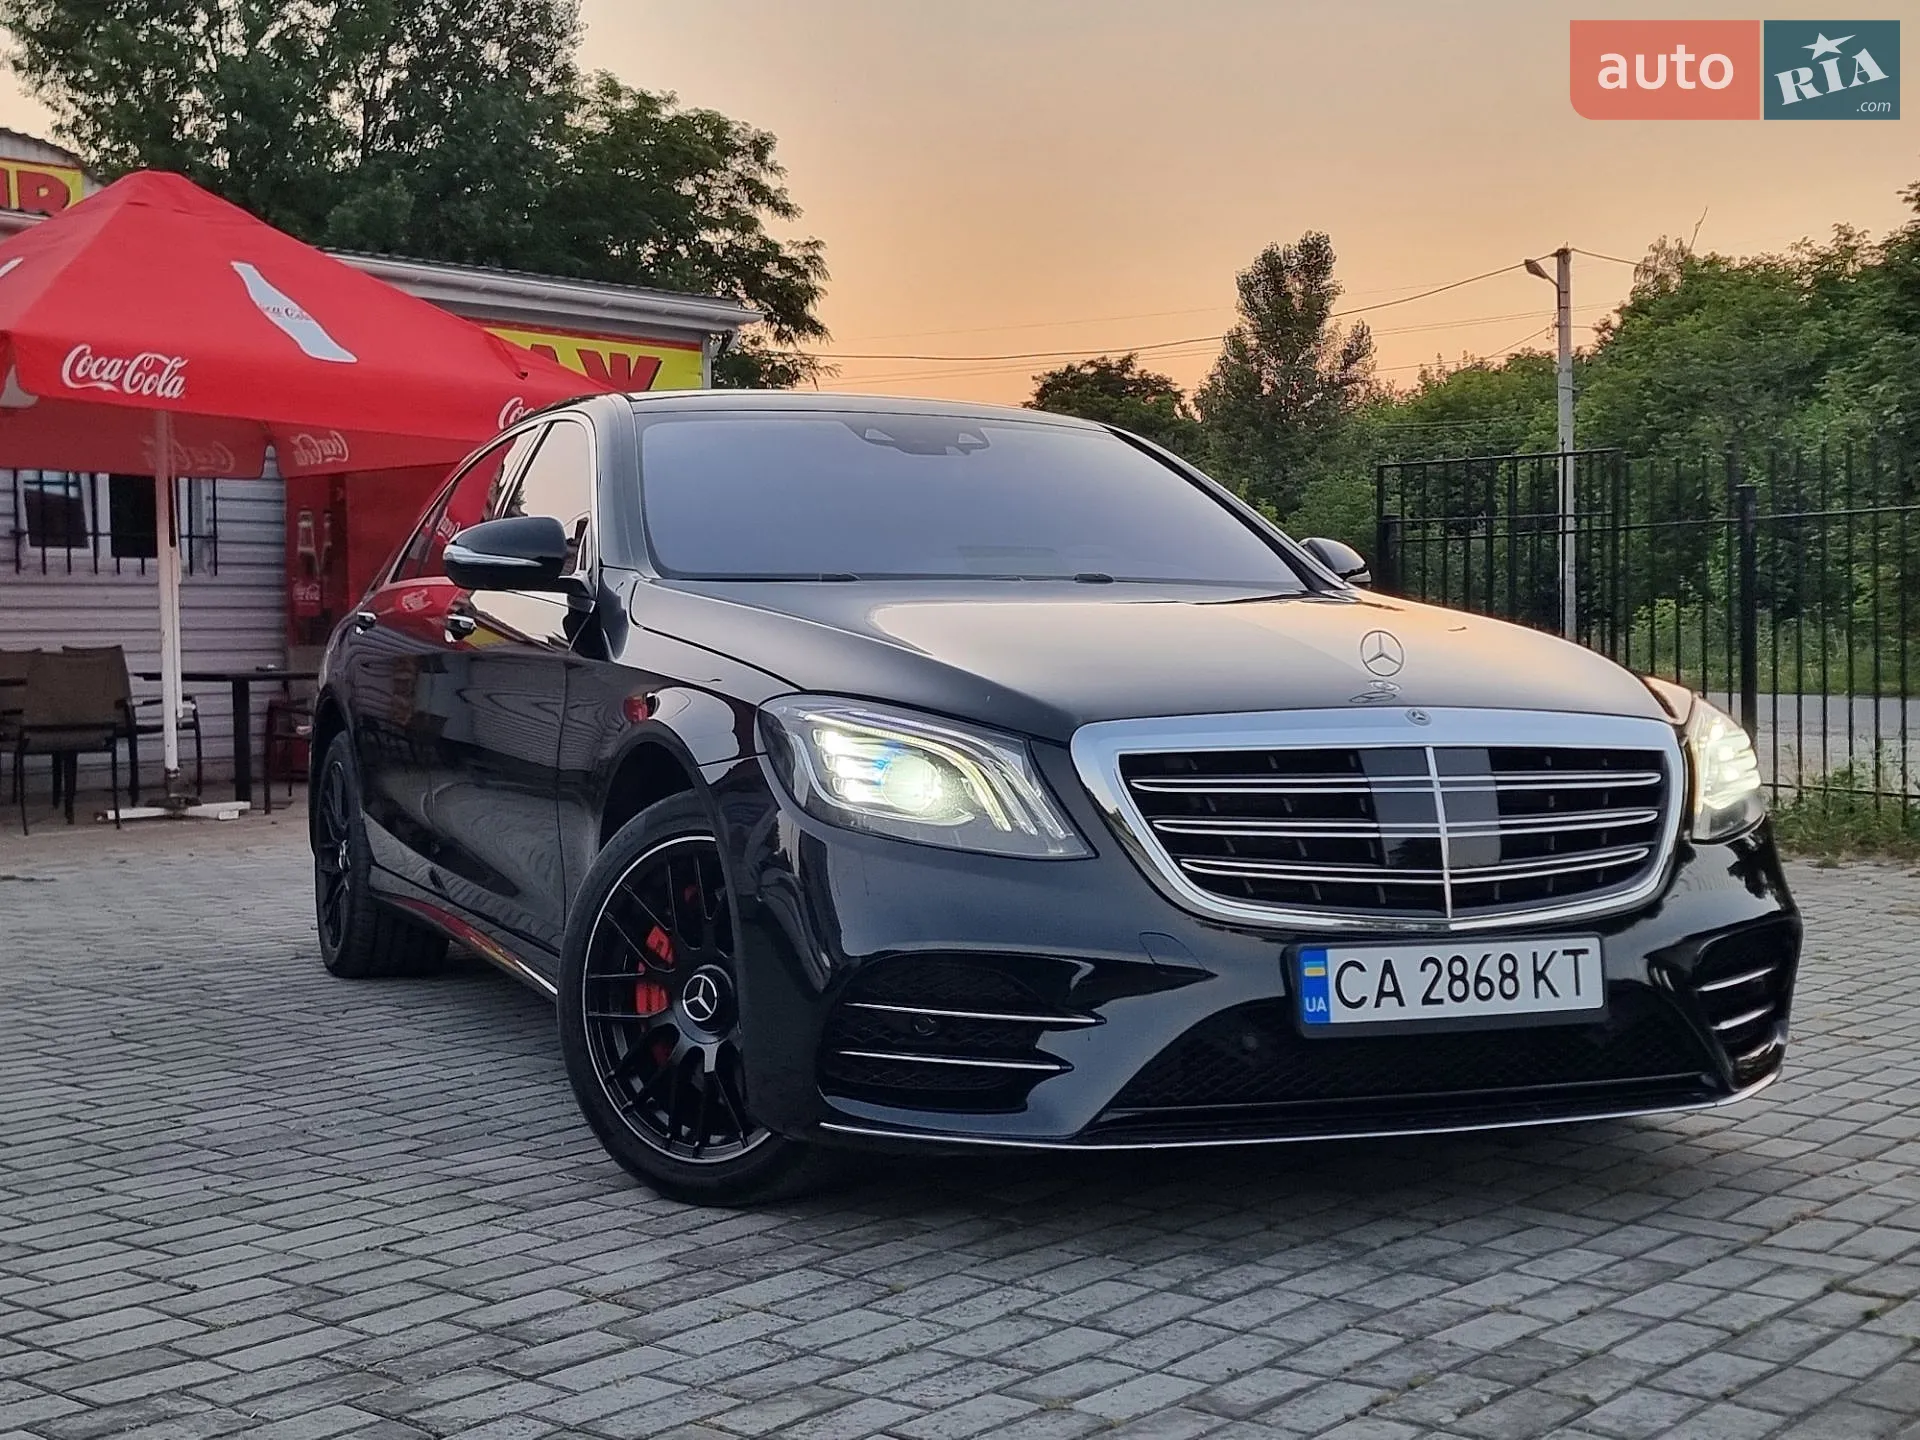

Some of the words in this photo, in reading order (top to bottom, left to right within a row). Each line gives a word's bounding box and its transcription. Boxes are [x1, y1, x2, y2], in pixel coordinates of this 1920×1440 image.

[61, 344, 189, 399] Coca-Cola
[1305, 995, 1328, 1013] UA
[1334, 958, 1406, 1010] CA
[1419, 952, 1521, 1006] 2868
[1531, 948, 1590, 1000] KT
